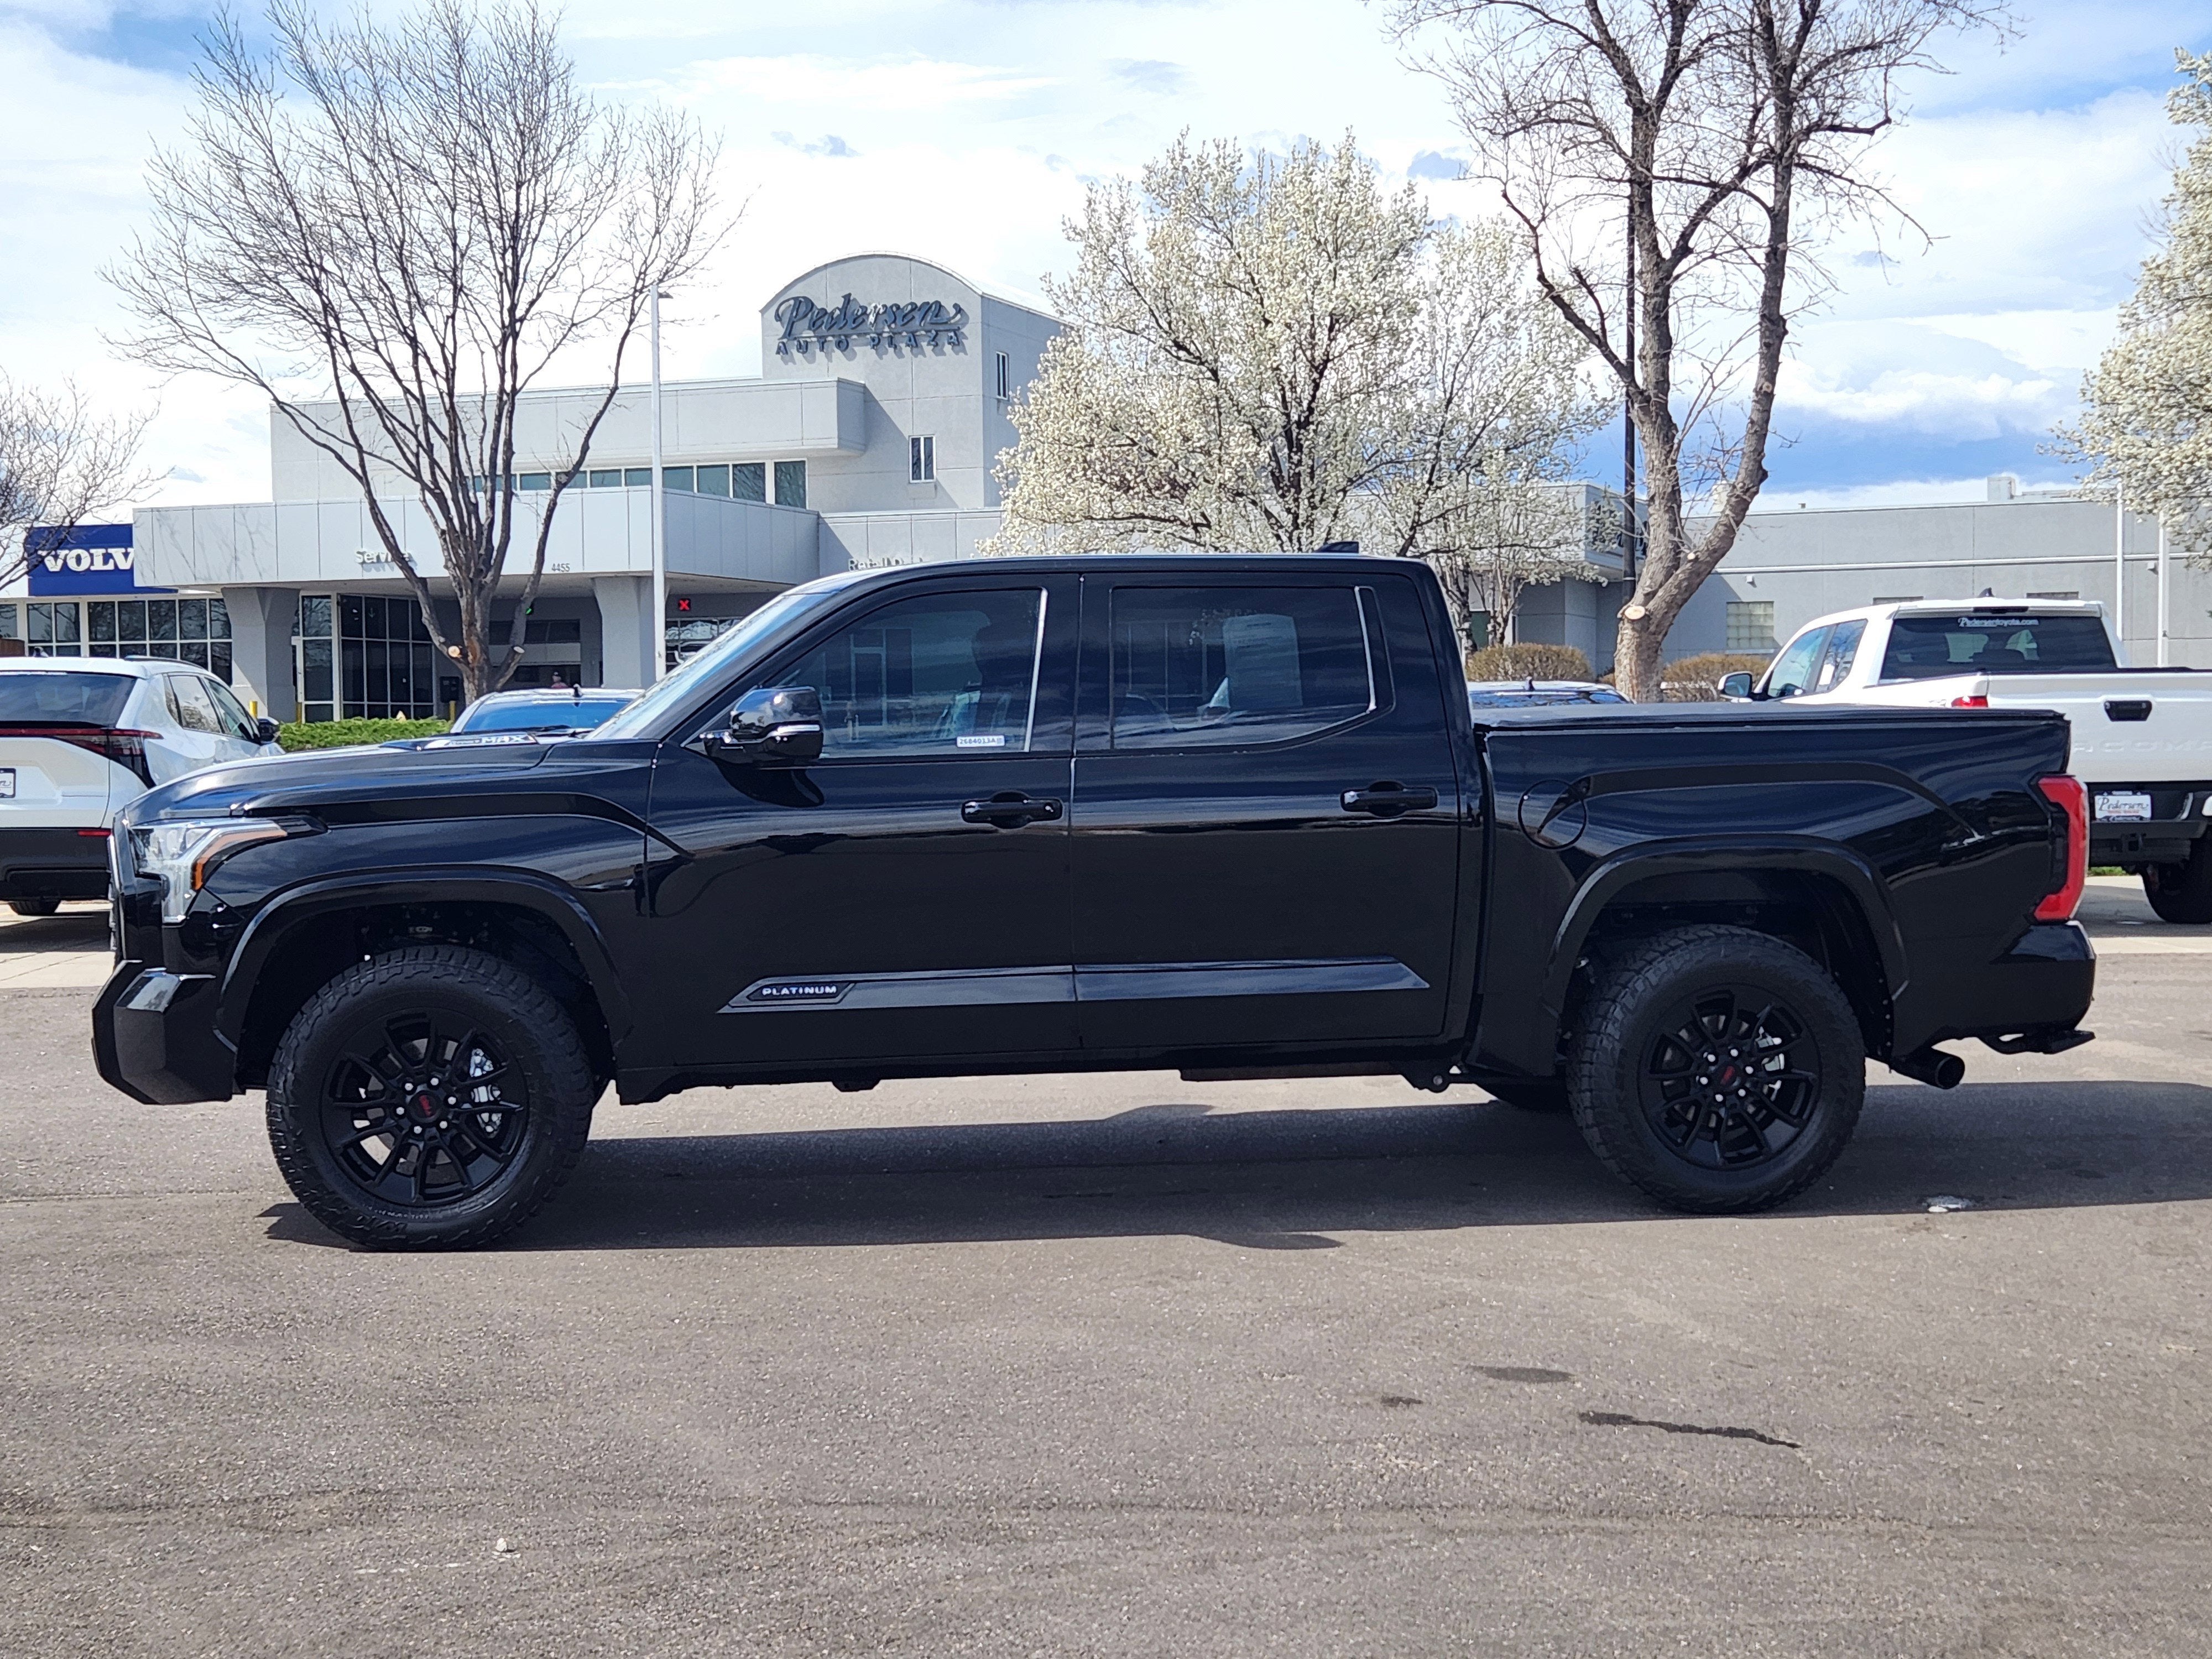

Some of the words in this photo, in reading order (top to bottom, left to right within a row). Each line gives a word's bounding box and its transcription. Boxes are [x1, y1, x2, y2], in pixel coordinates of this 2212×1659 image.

[775, 293, 962, 341] Pedersen
[775, 335, 850, 355] AUTO
[869, 330, 961, 351] PLAZA
[37, 548, 134, 572] VOLV
[551, 563, 570, 572] 4455
[2070, 739, 2212, 753] ACOMA
[761, 985, 837, 996] PLATINUM
